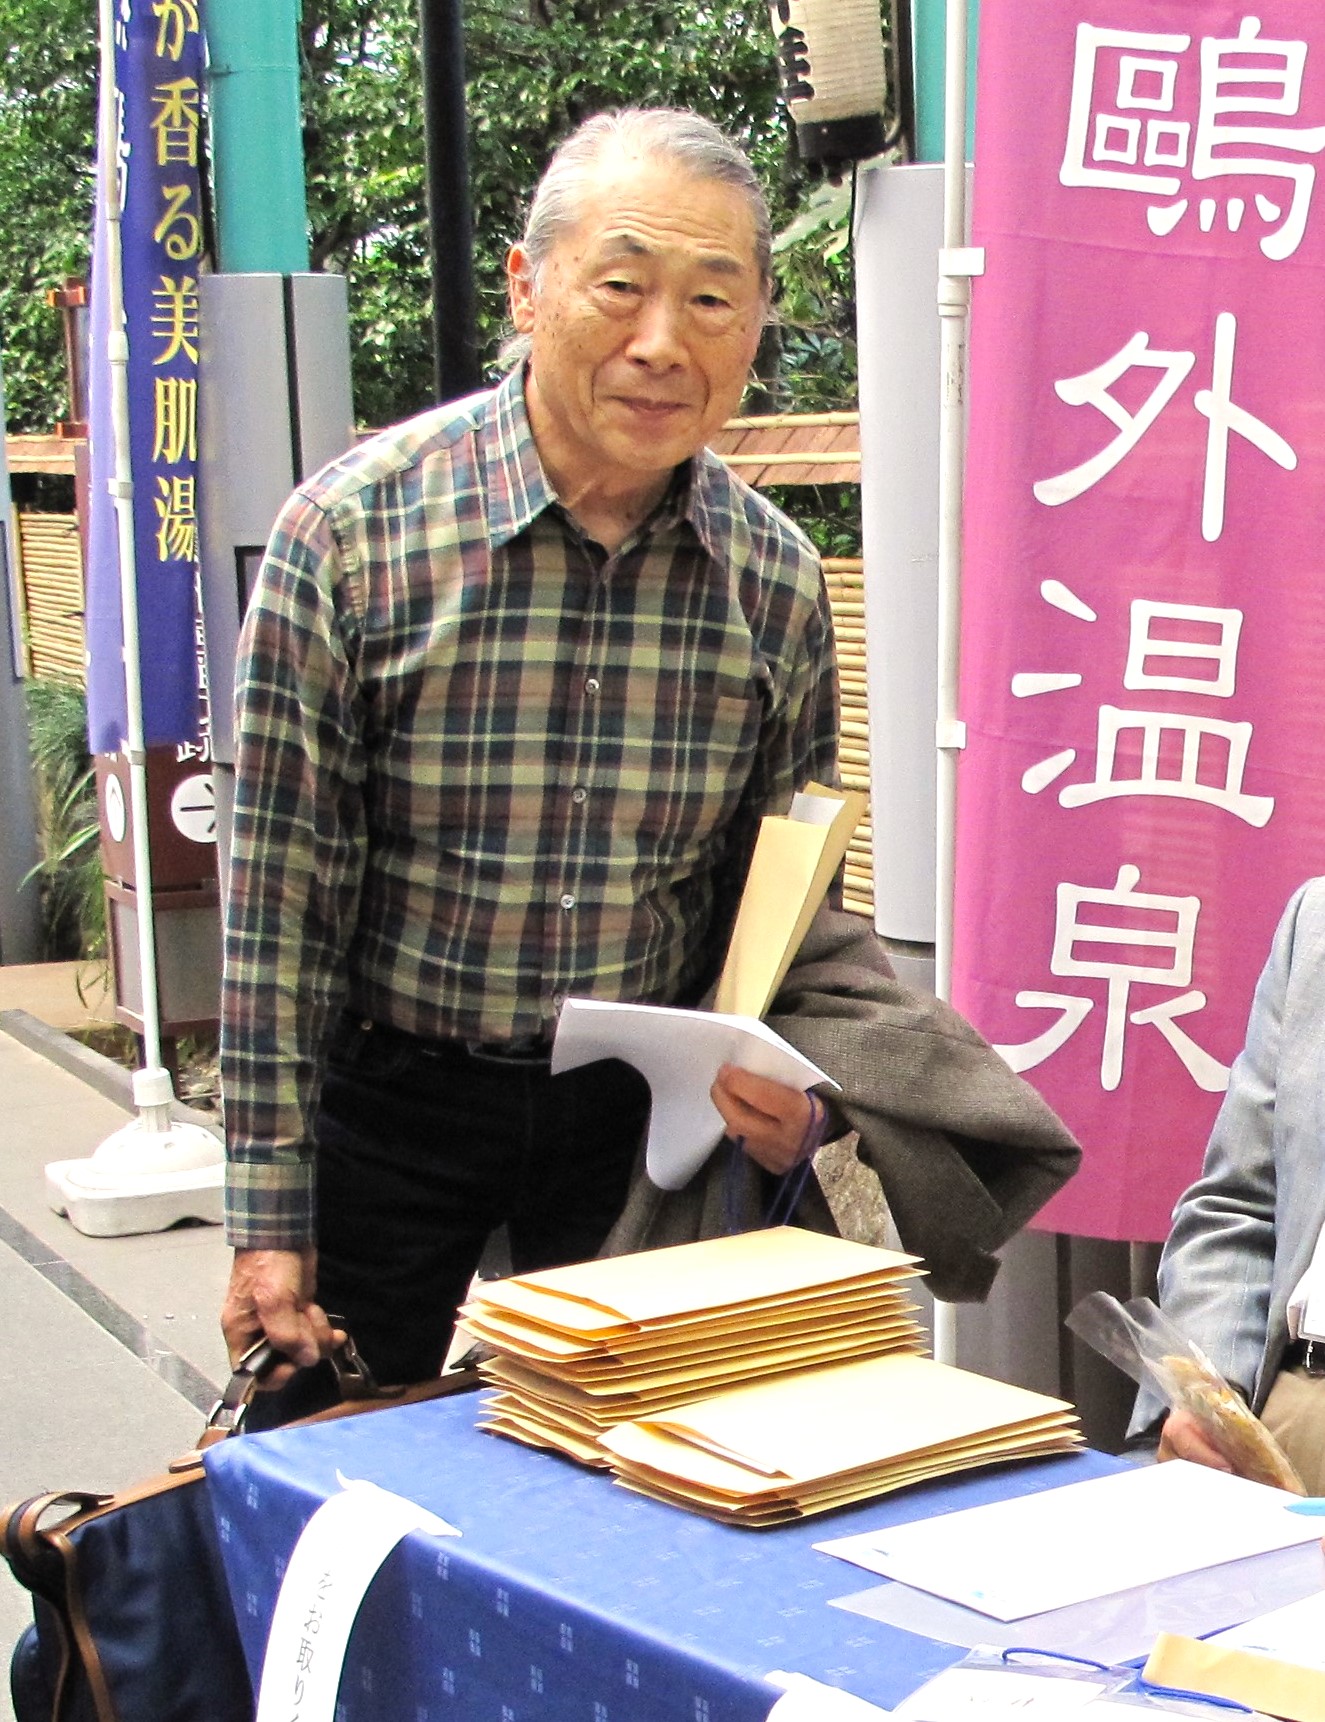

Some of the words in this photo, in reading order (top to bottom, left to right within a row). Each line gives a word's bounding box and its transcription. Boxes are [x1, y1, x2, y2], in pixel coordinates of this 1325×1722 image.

[151, 0, 199, 563] が香る美肌湯
